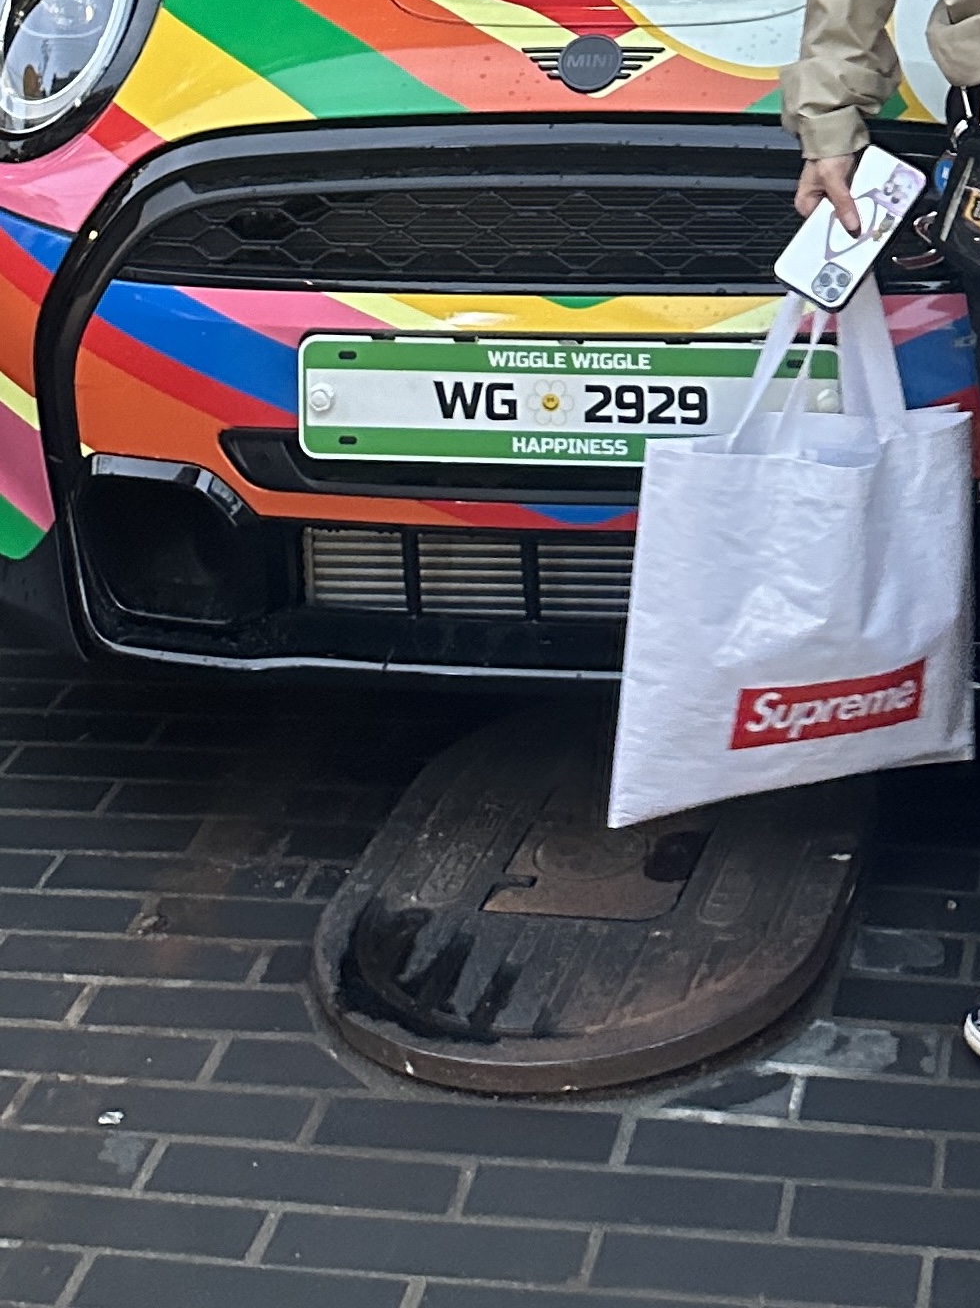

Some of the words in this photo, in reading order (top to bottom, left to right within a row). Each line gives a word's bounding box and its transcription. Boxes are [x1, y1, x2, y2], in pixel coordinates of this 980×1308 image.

[566, 53, 613, 68] MINI
[487, 350, 567, 368] WIGGLE
[571, 352, 652, 370] WIGGLE
[433, 380, 518, 421] WG
[584, 384, 708, 425] 2929
[512, 436, 628, 455] HAPPINESS
[745, 679, 918, 739] Supreme
